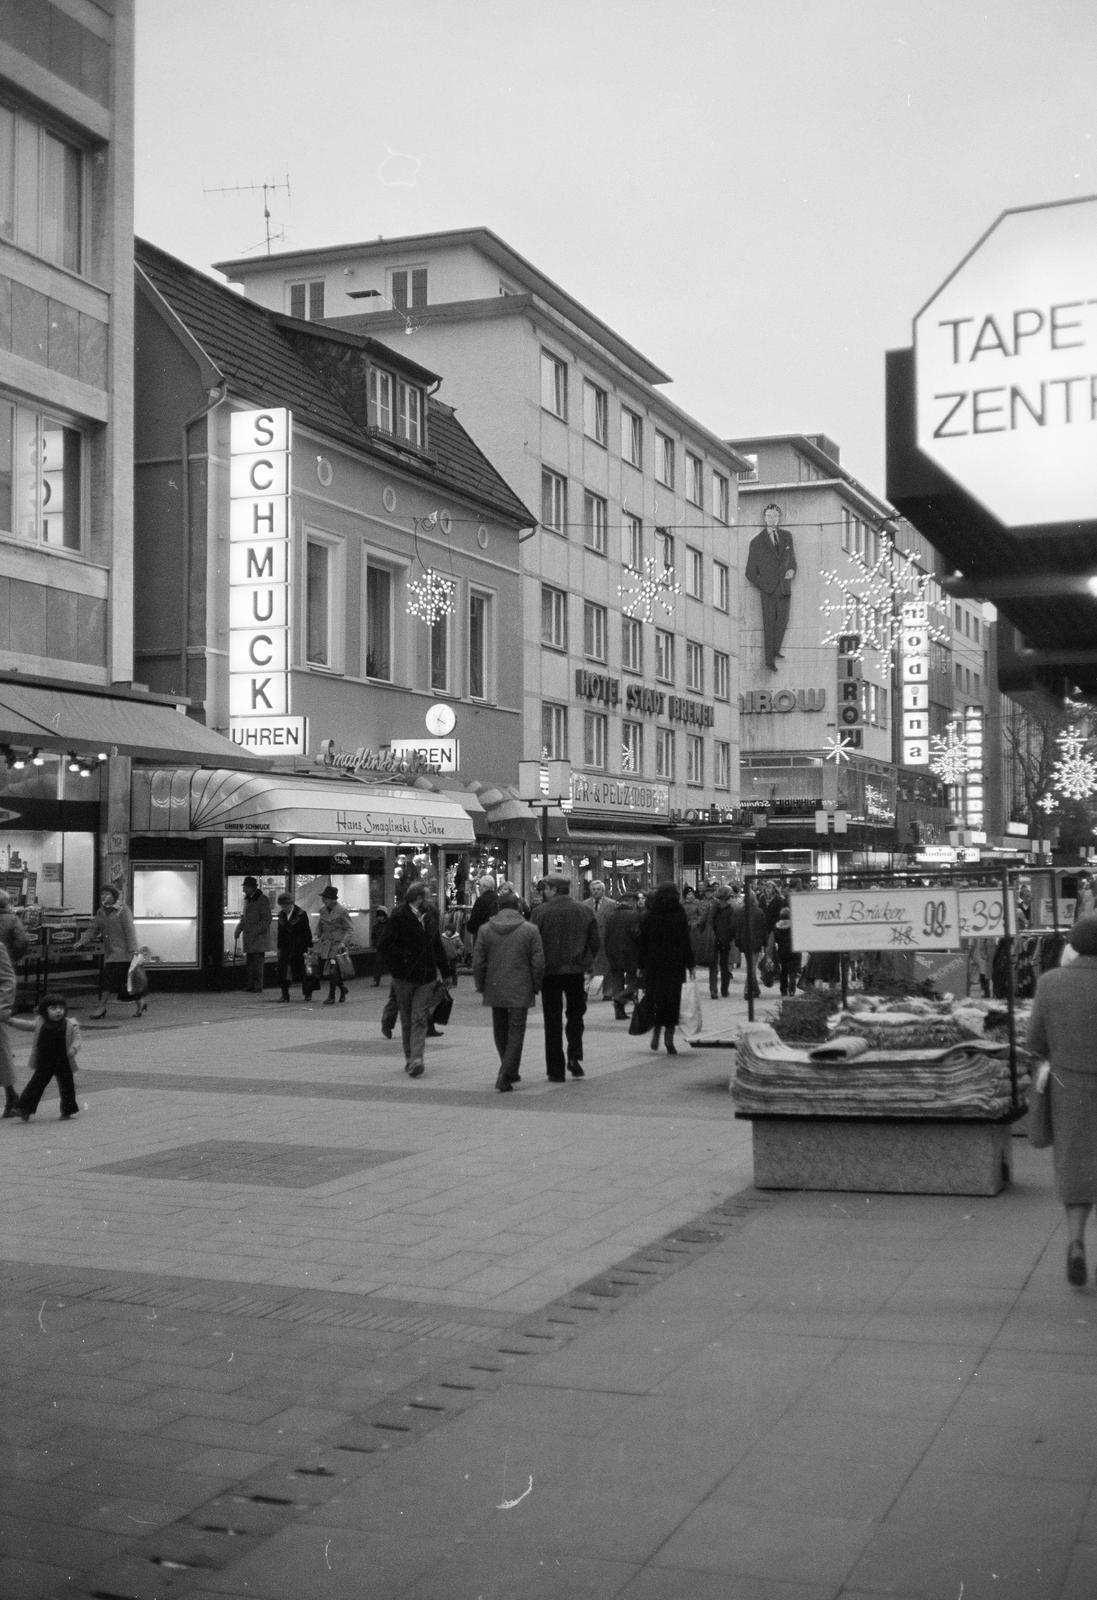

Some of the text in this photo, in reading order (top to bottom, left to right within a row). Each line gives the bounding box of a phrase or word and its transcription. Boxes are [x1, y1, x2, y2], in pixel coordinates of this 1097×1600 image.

[246, 413, 276, 712] SCHMUCK
[575, 668, 715, 727] HOTEL STADT BREMEN
[231, 727, 300, 747] UHREN
[335, 811, 445, 837] Hans Smaglinski & Söhne
